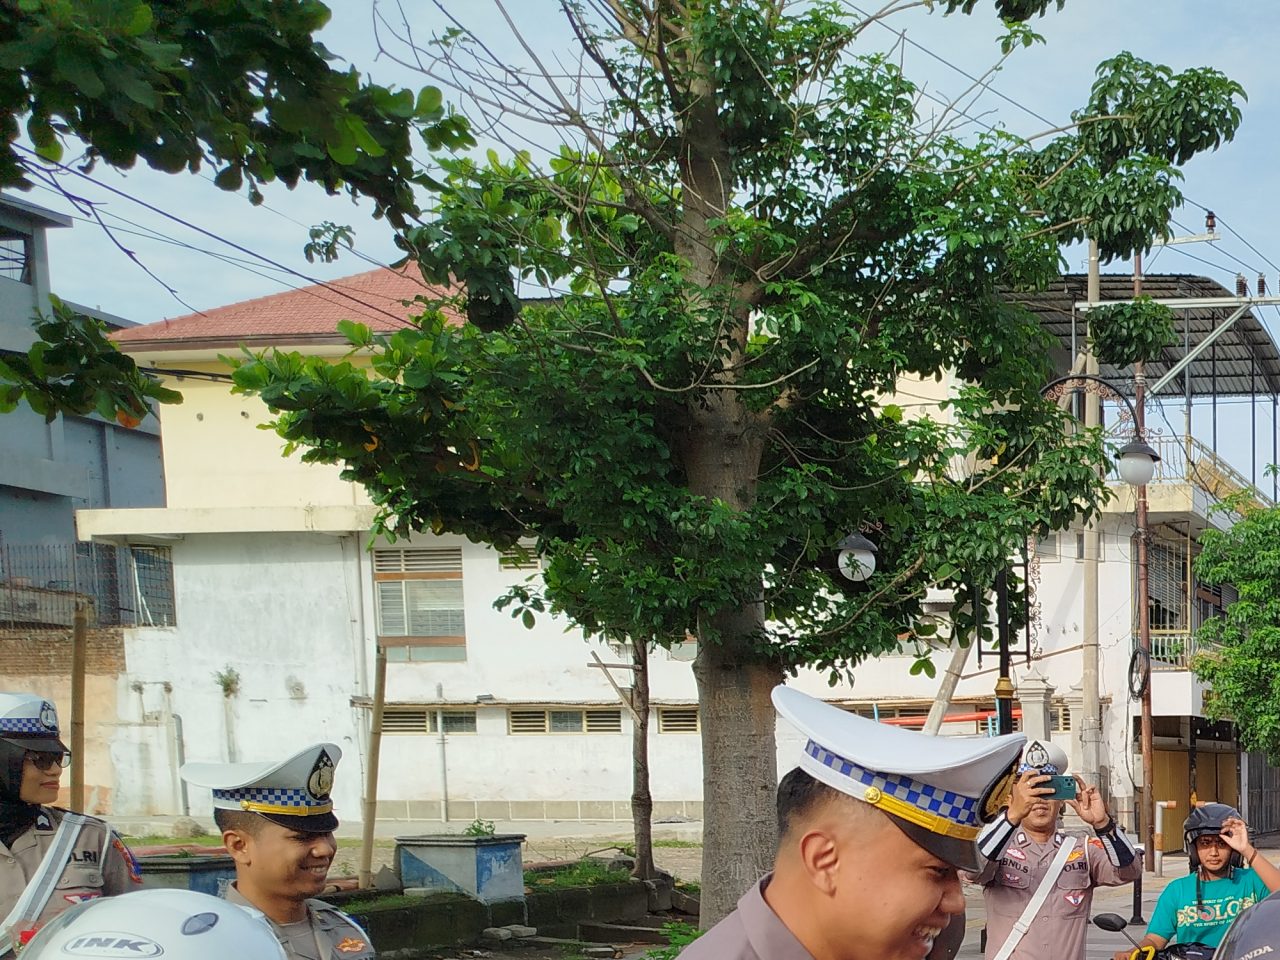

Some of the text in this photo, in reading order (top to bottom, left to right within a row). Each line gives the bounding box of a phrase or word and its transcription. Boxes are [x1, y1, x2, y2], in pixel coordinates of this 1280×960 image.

[1064, 861, 1089, 873] OLRI
[1187, 900, 1240, 923] SOLO
[71, 937, 150, 952] INK
